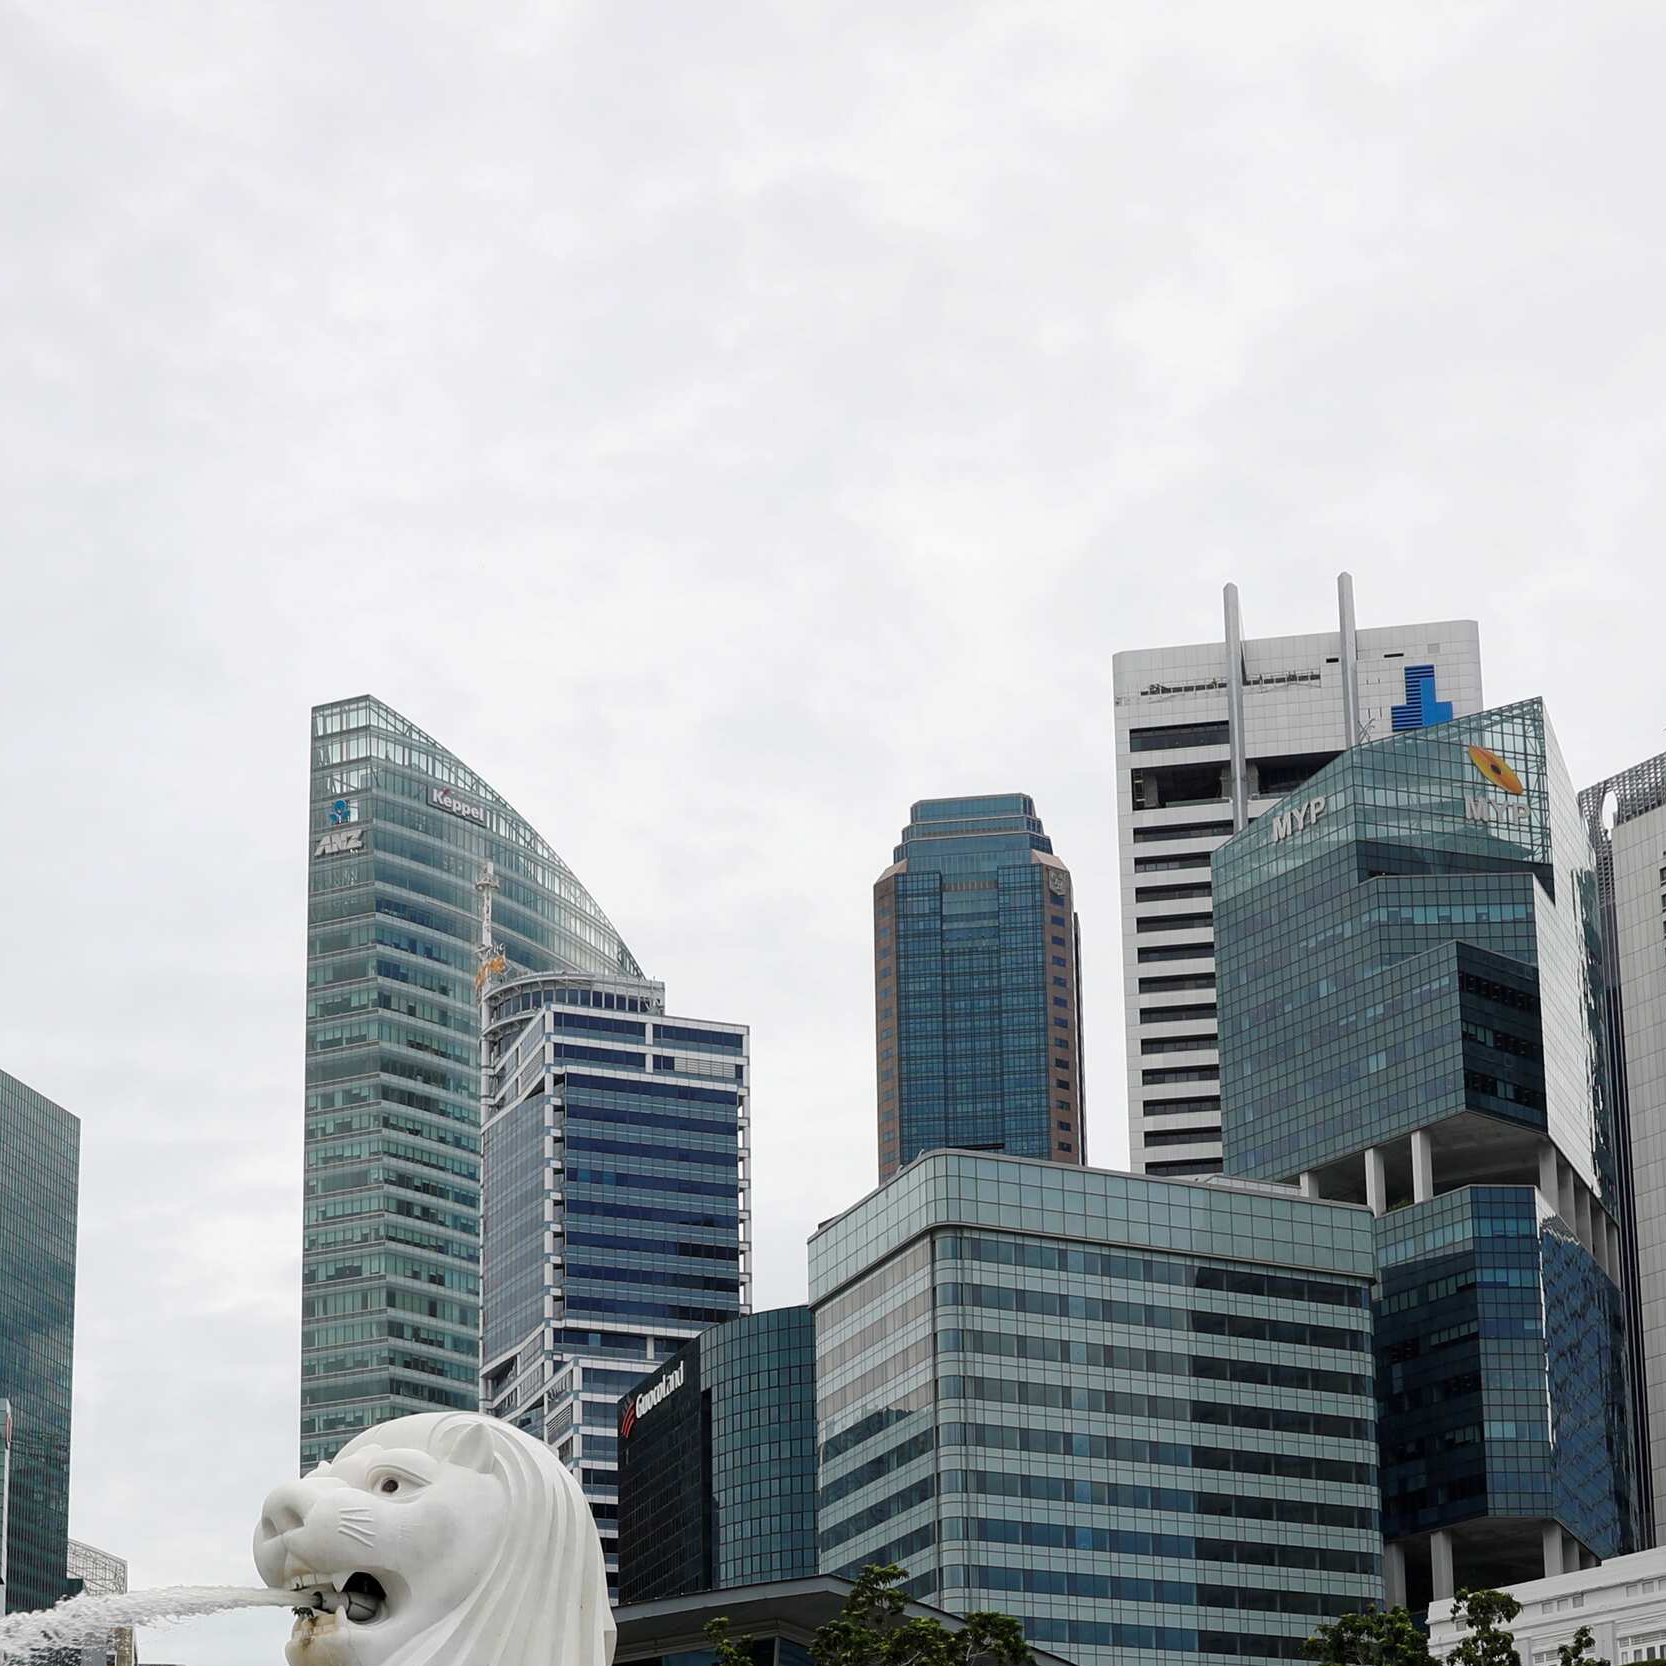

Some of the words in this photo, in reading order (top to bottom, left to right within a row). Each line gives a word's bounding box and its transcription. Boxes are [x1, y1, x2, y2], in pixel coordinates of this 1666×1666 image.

[432, 787, 485, 822] Keppel
[1271, 796, 1326, 841] MYP
[1464, 795, 1530, 826] MYP
[314, 830, 364, 857] ANZ
